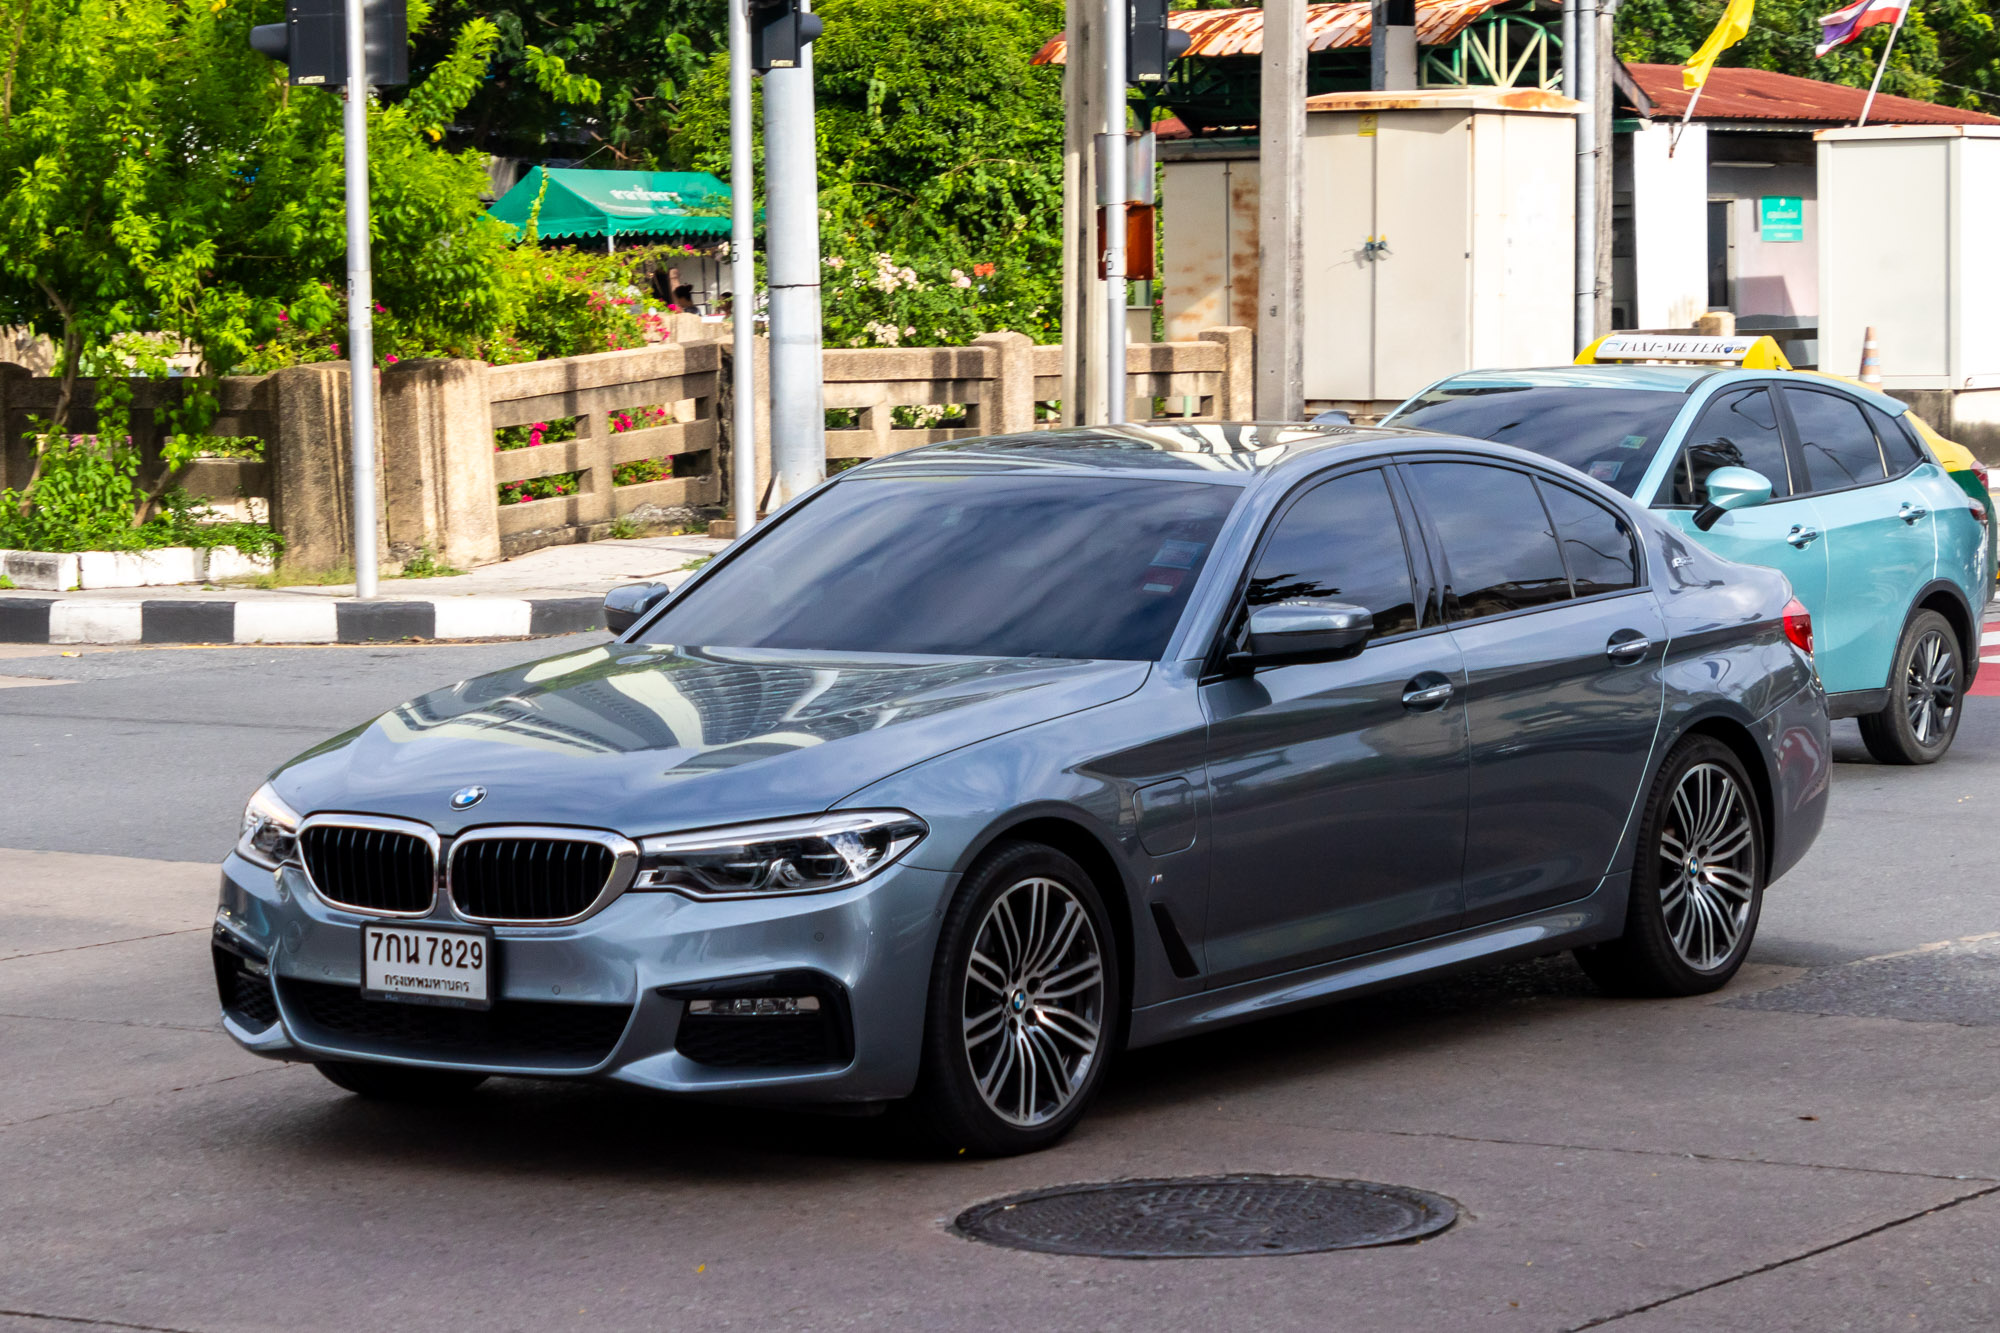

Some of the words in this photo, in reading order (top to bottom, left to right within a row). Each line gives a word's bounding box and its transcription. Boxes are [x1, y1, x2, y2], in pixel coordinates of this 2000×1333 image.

[1620, 342, 1724, 353] TAXI-METER
[370, 931, 419, 964] 7กน
[426, 936, 483, 969] 7829
[384, 973, 470, 992] กรุงเทพมหานคร
